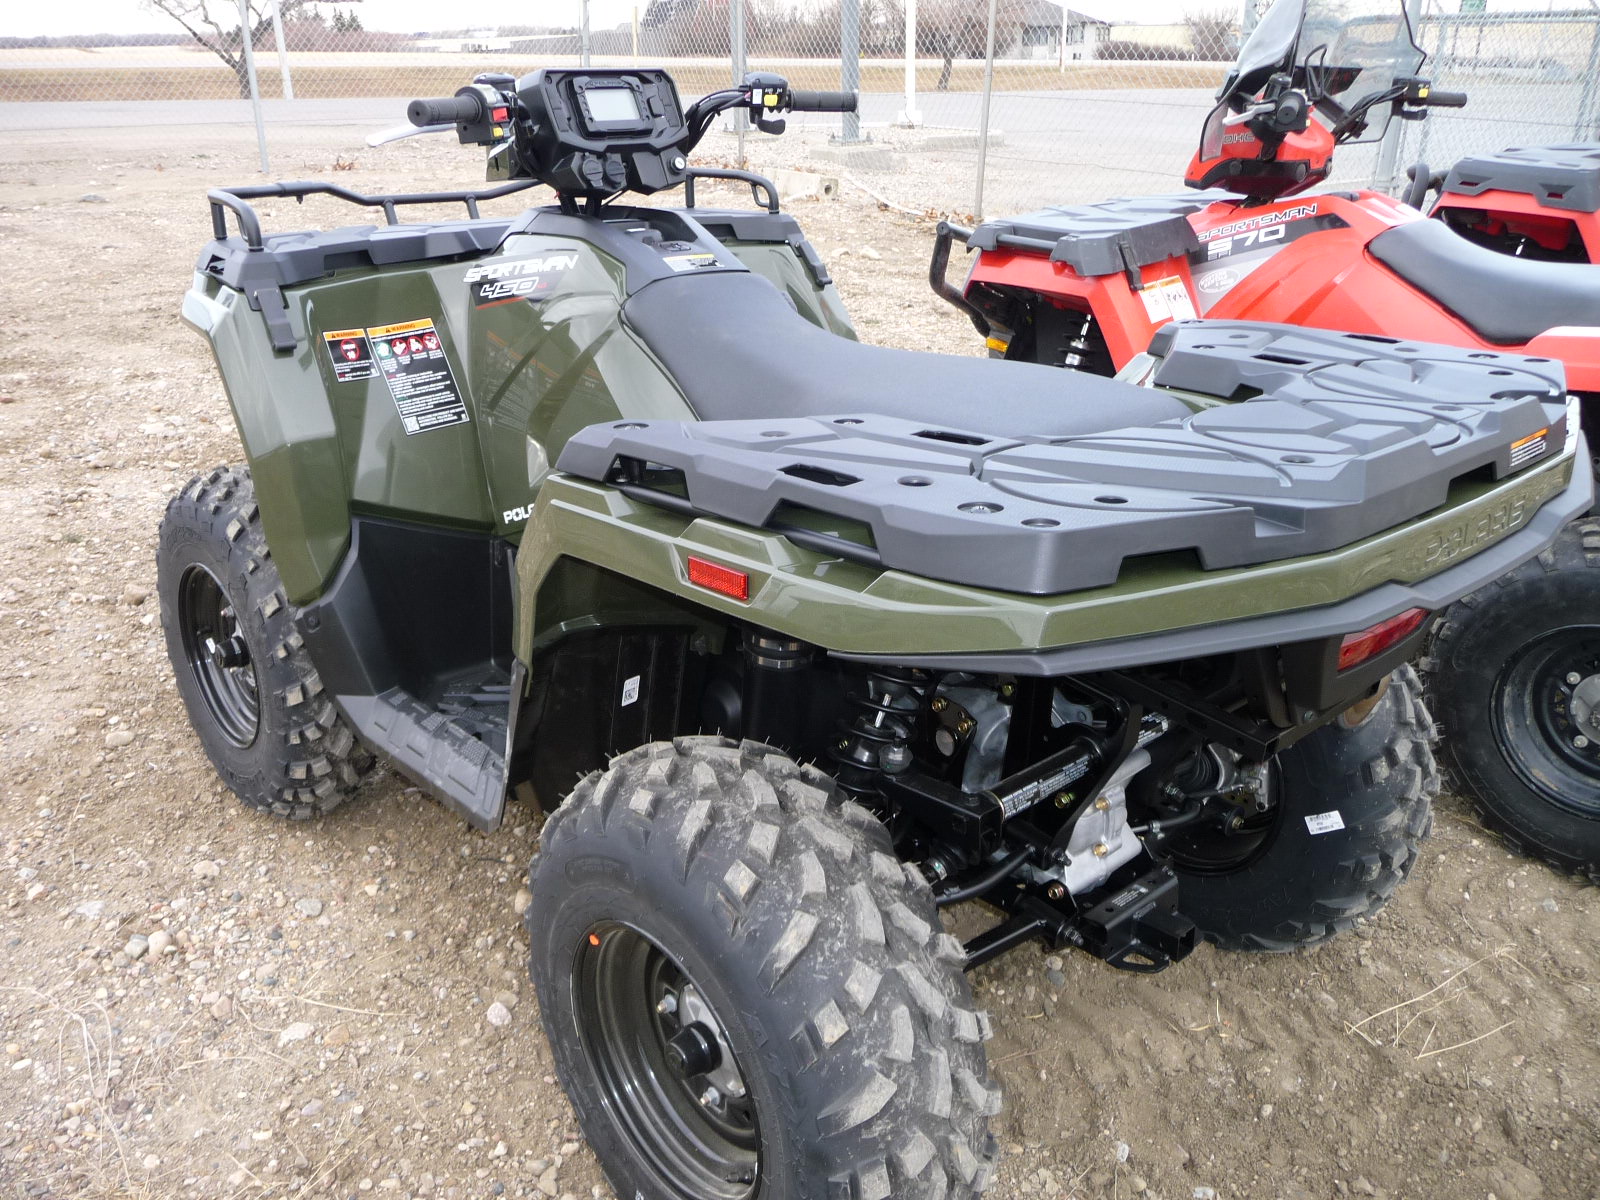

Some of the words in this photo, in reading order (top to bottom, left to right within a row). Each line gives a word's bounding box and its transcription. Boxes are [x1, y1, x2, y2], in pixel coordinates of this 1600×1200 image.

[1196, 203, 1318, 242] SPORTSMAN
[1207, 223, 1286, 256] 570
[463, 254, 579, 283] SPORTSMAN
[480, 276, 540, 299] 450
[392, 323, 416, 331] WARNING
[1421, 496, 1527, 570] POLARIS
